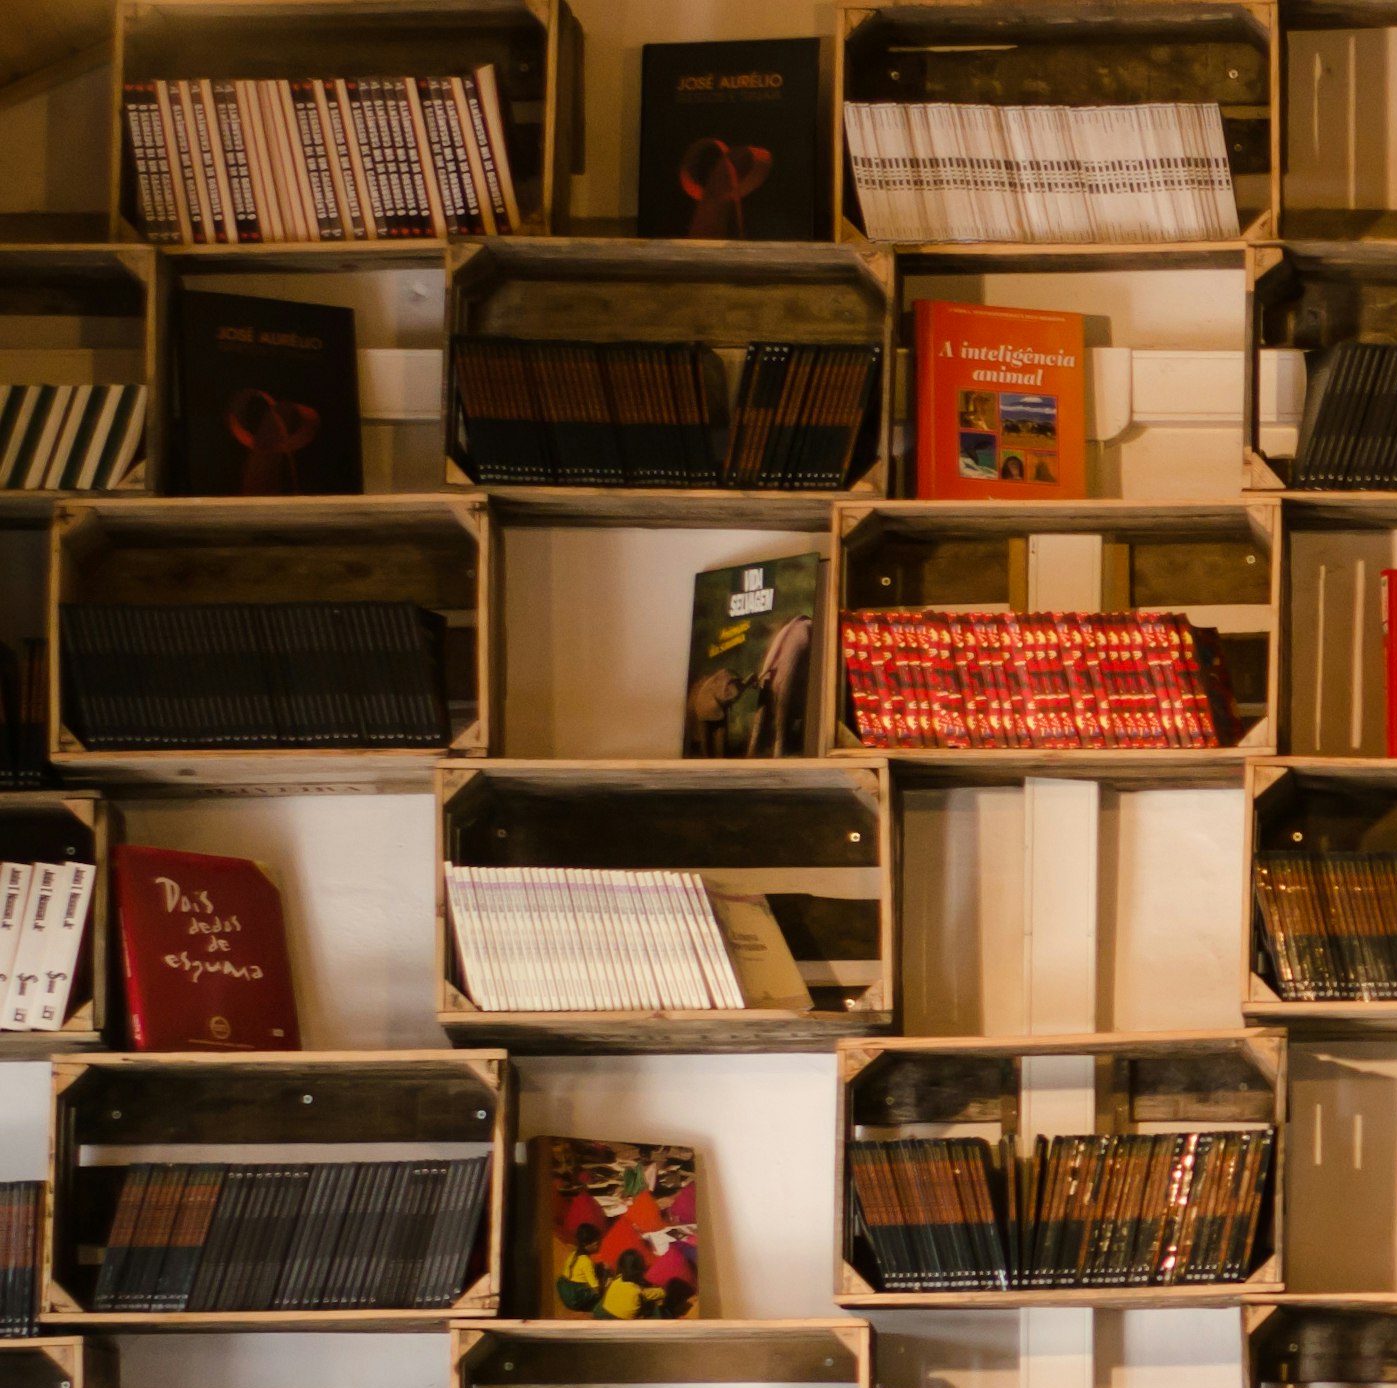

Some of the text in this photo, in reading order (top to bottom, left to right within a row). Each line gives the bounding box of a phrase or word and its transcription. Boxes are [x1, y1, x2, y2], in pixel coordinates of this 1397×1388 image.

[678, 72, 783, 91] JOSÉ AURÉLIO
[217, 326, 254, 342] JOSÉ
[938, 341, 1076, 369] A inteligência
[972, 367, 1044, 387] animal
[153, 876, 214, 914] Dois
[189, 915, 242, 935] dedos
[208, 935, 231, 952] de
